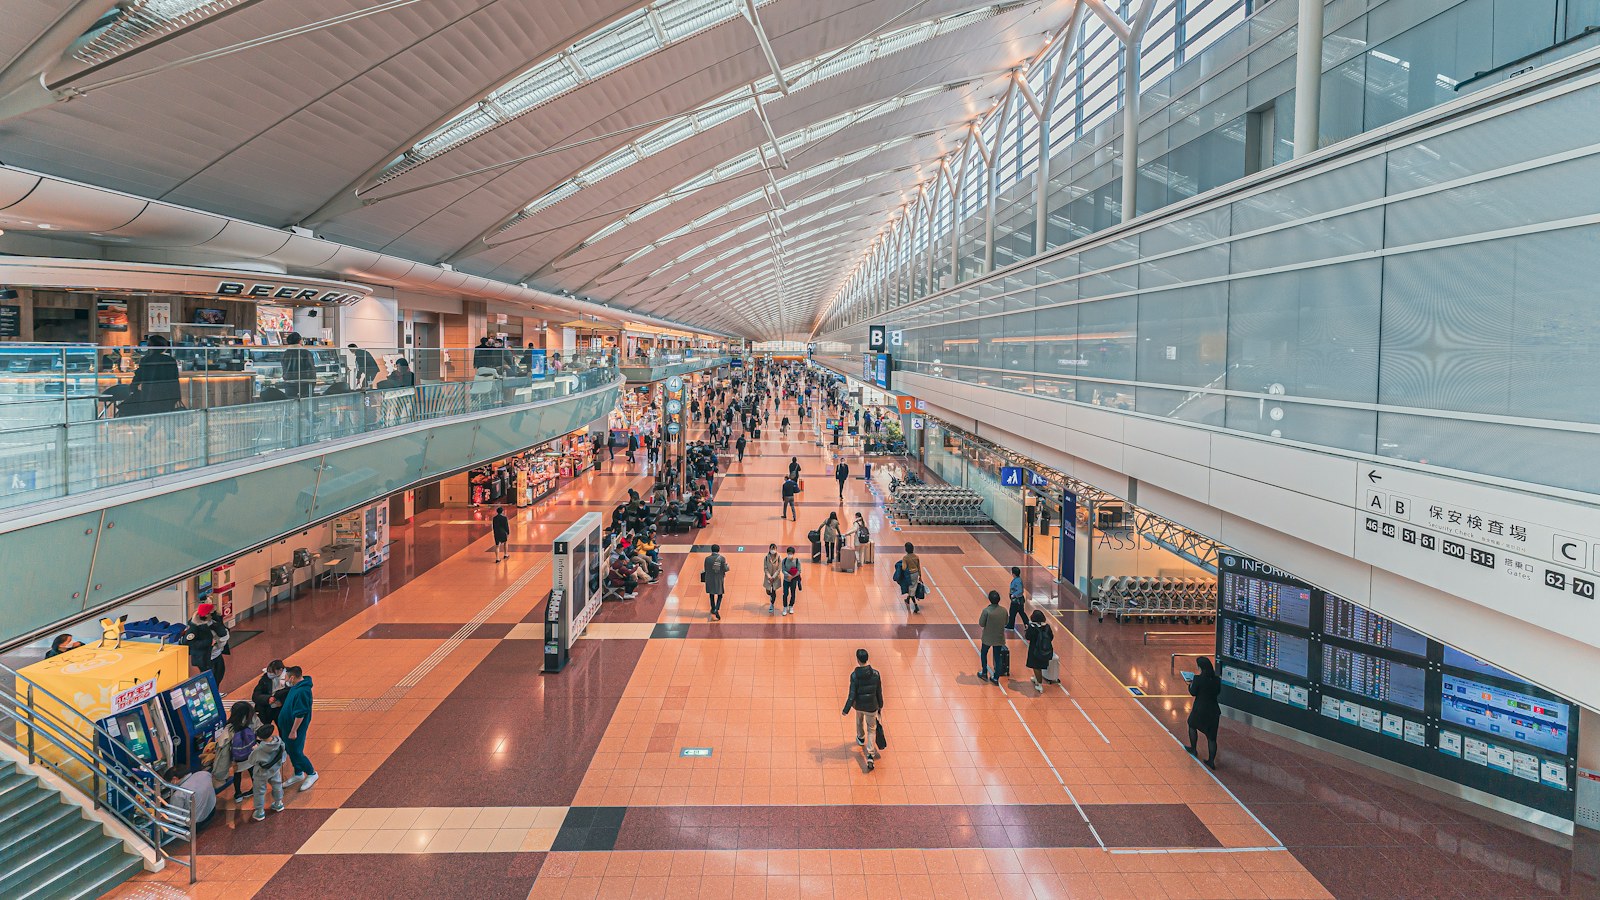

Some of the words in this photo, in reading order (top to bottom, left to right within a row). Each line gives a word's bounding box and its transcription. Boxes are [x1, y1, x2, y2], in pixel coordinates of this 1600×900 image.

[217, 281, 319, 300] BEER
[871, 330, 883, 346] B
[670, 378, 678, 388] 4
[905, 400, 912, 410] B
[1371, 495, 1382, 509] A
[1395, 500, 1405, 514] B
[1428, 521, 1453, 533] Security
[1454, 528, 1474, 538] Check
[1429, 504, 1526, 542] 保安検査場
[1366, 520, 1377, 531] 46
[1383, 525, 1394, 536] 48
[1404, 530, 1415, 542] 51
[1422, 536, 1434, 548] 61
[1444, 542, 1464, 557] 500
[1472, 550, 1493, 566] 513
[1561, 542, 1577, 561] C
[1504, 558, 1534, 573] 搭乗口
[1506, 568, 1531, 580] Gates
[1546, 573, 1563, 588] 62
[1574, 580, 1593, 596] 70
[115, 681, 153, 704] ポケモン
